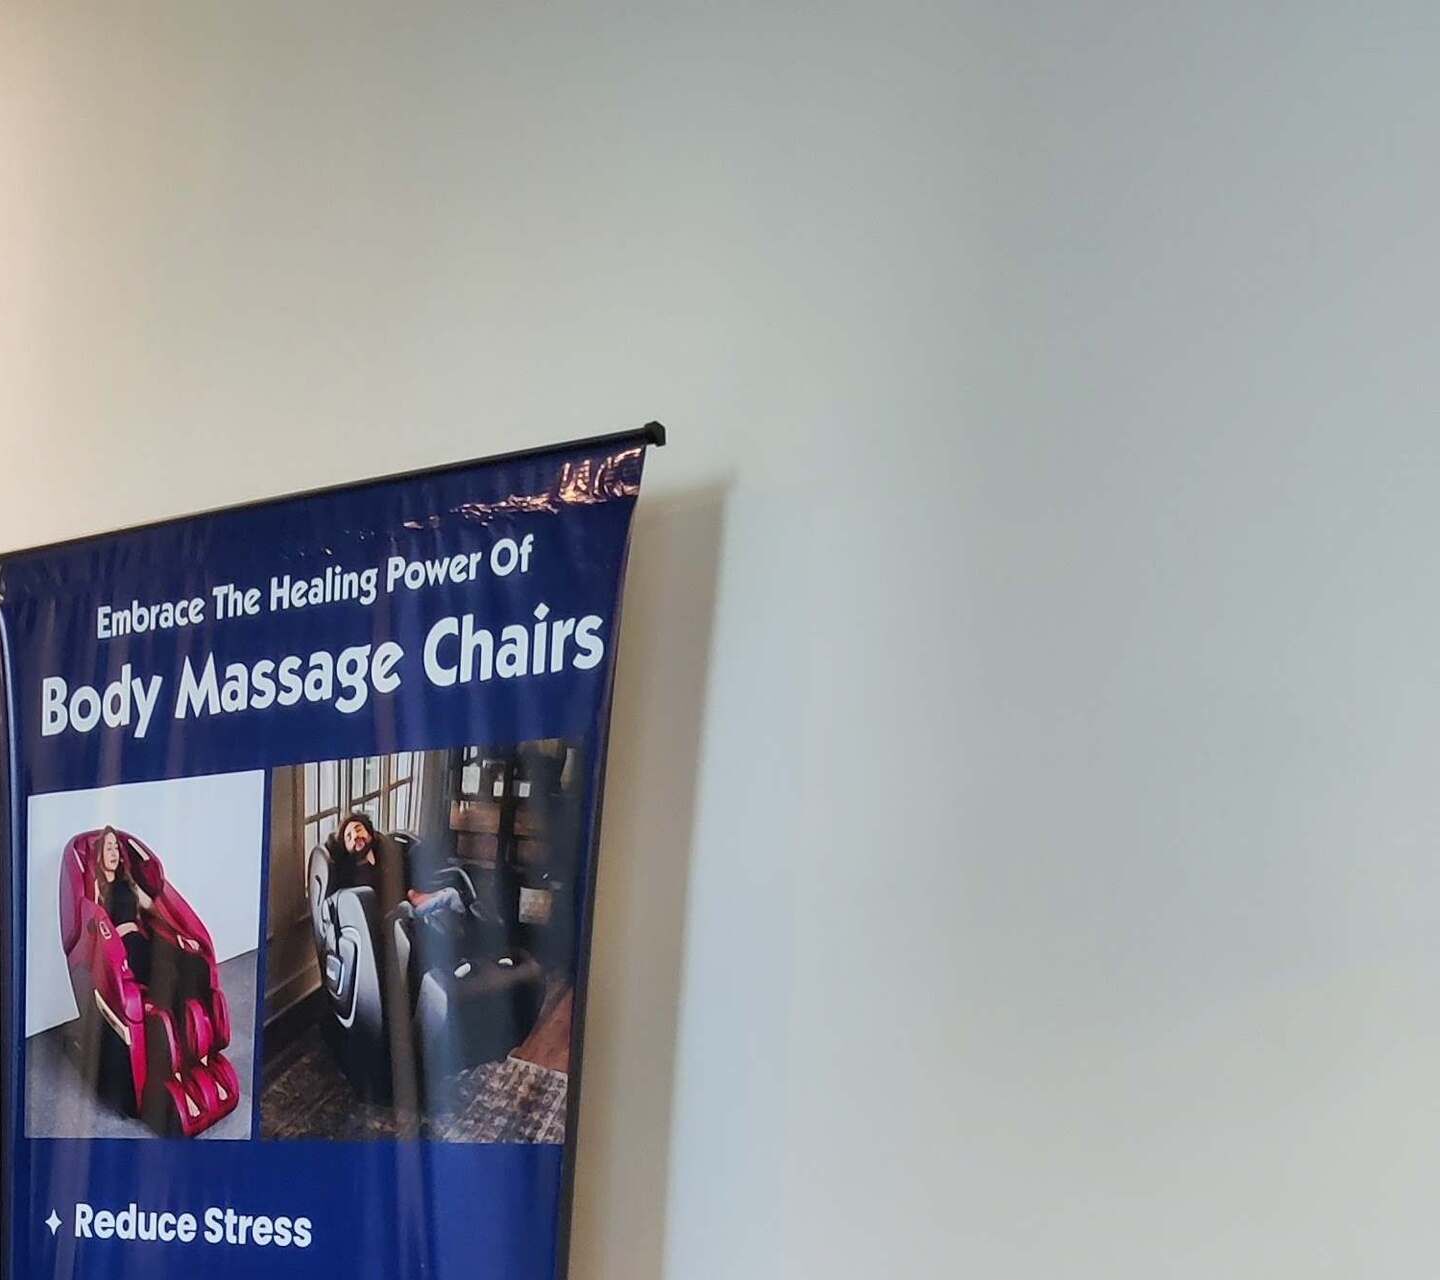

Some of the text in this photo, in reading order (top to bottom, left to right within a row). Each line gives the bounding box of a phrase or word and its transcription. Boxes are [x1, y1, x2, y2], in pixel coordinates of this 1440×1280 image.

[97, 533, 534, 639] Embrace The Healing Power Of
[41, 602, 605, 738] Body Massage Chairs
[74, 1203, 312, 1248] Reduce Stress
